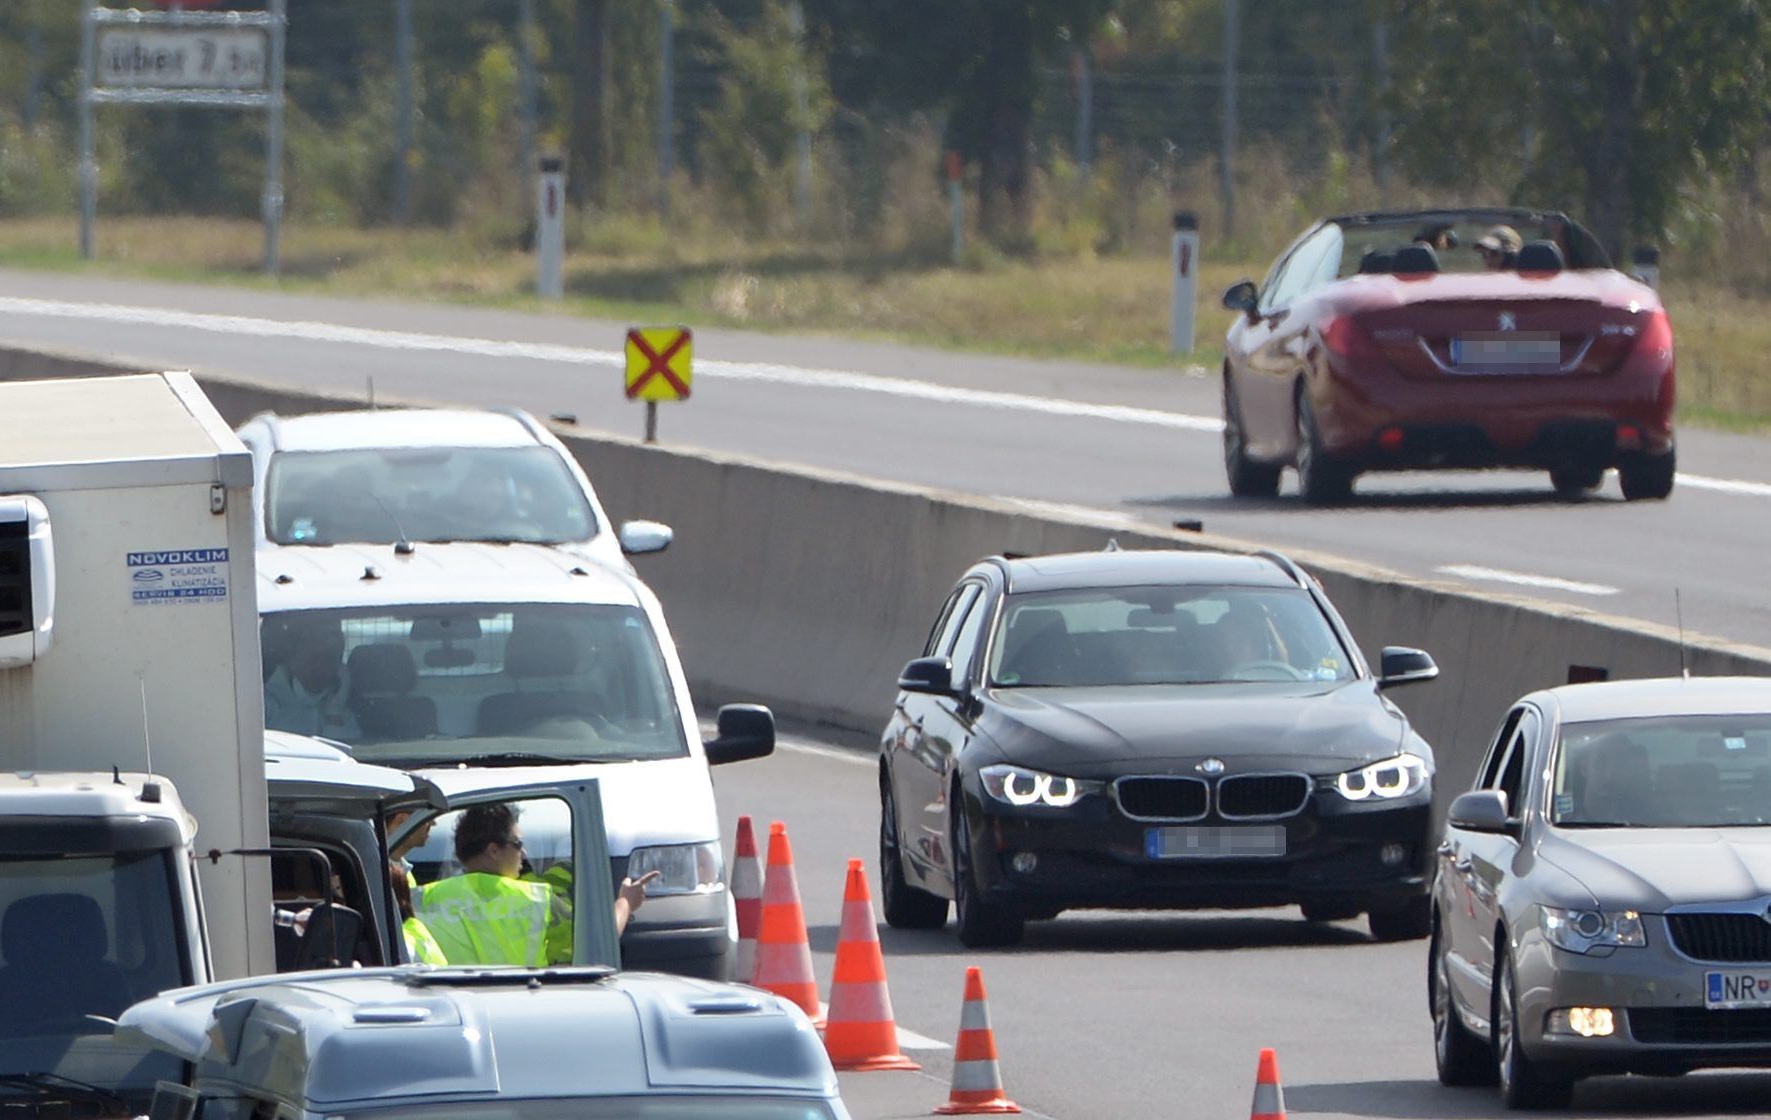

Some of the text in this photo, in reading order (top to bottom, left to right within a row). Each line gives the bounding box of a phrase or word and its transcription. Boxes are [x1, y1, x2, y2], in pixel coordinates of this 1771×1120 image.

[129, 551, 226, 565] NOVOKLIM
[133, 590, 175, 599] SERVIS
[1725, 975, 1756, 1000] NR
